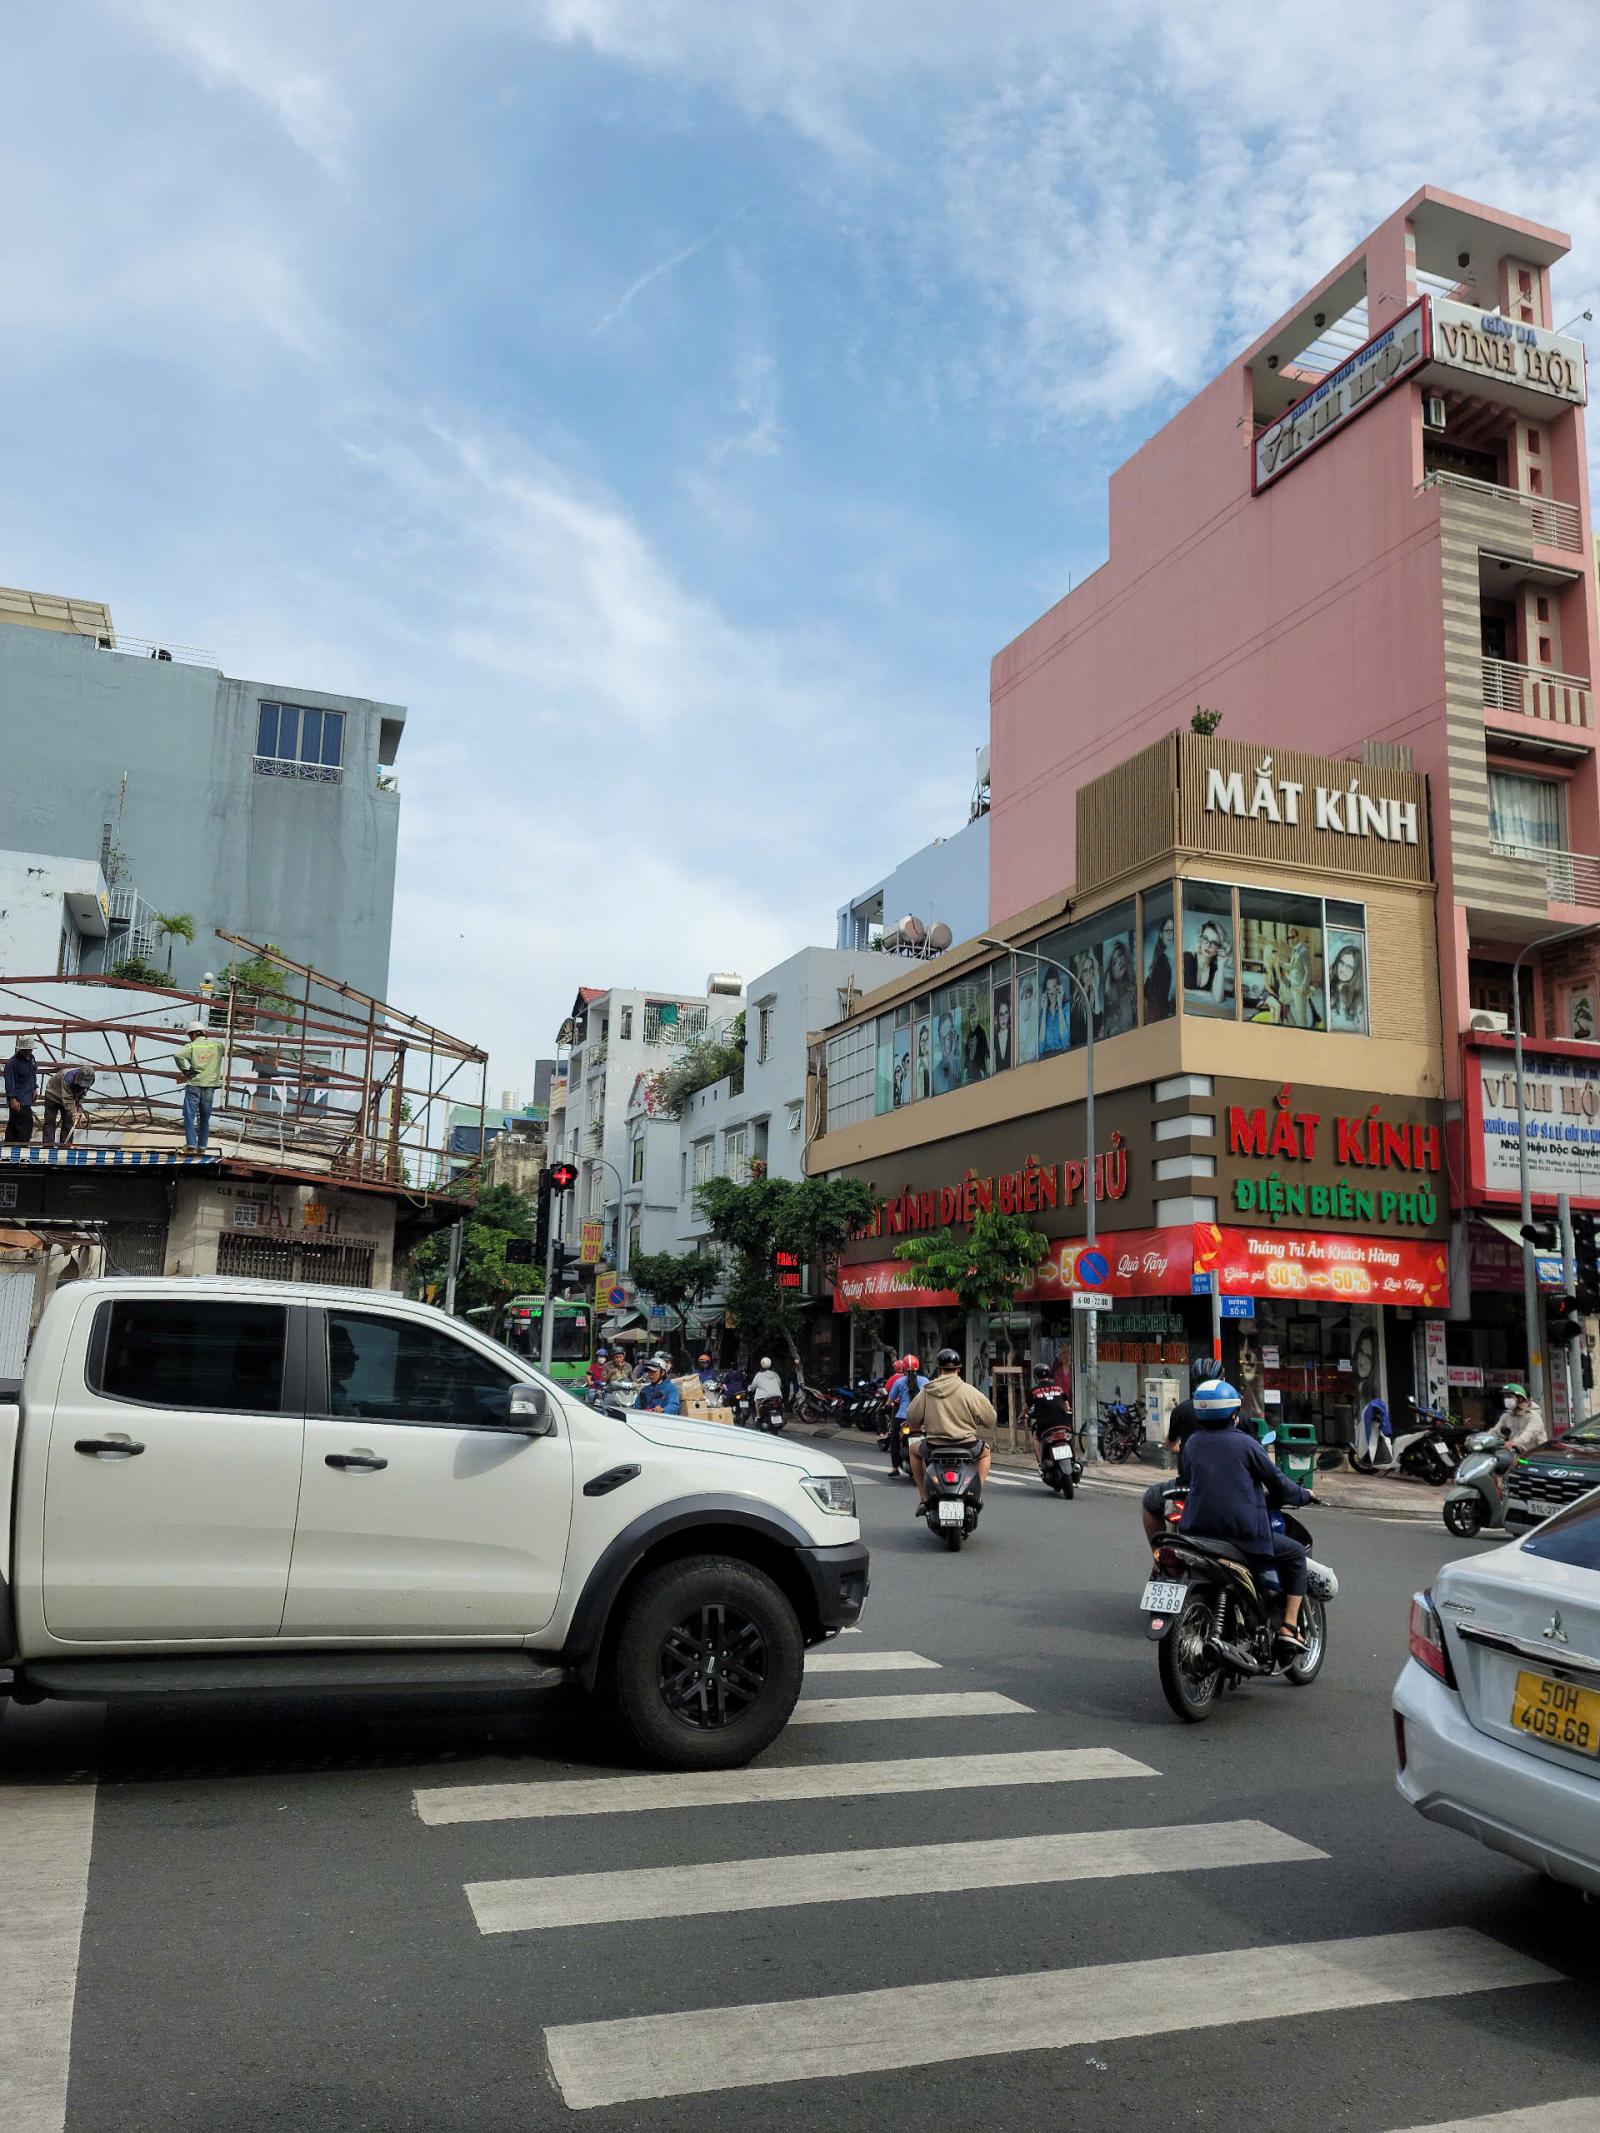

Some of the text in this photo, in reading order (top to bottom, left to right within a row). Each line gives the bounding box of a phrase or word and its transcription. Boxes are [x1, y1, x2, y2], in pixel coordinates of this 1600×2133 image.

[1349, 329, 1420, 407] HỘI
[1441, 319, 1578, 394] VĨNH HỘI
[1205, 755, 1418, 844] MẮT KÍNH
[1560, 1081, 1600, 1125] HỘ
[1227, 1084, 1440, 1172] MẮT KÍNH
[1527, 1142, 1547, 1155] Hiệu
[1550, 1144, 1568, 1156] Độc
[886, 1183, 936, 1234] KÍNH
[941, 1168, 993, 1234] ĐIỆN
[999, 1154, 1058, 1215] BIÊN
[1065, 1130, 1127, 1206] PHỦ
[1235, 1171, 1437, 1225] ĐIỆN BIÊN PHỦ
[583, 1225, 602, 1242] PHOTO
[584, 1246, 599, 1261] COPY
[1116, 1254, 1139, 1279] Quà
[1143, 1251, 1168, 1278] Tặng
[1248, 1239, 1400, 1266] Tháng Tri Ân Khách Hàng
[876, 1272, 889, 1294] Ân
[1224, 1266, 1248, 1283] Giảm
[1268, 1265, 1306, 1288] 30%
[1332, 1269, 1370, 1292] 50%
[1383, 1278, 1401, 1291] Quà
[1404, 1278, 1424, 1294] Tặng
[1124, 1311, 1145, 1332] CÔNG
[1169, 1314, 1183, 1333] 5.0
[1230, 1305, 1239, 1315] SỐ
[1144, 1597, 1180, 1611] 125.89
[1151, 1584, 1179, 1597] 59-S1
[1540, 1680, 1579, 1715] 50H
[1520, 1707, 1590, 1749] 409.68
